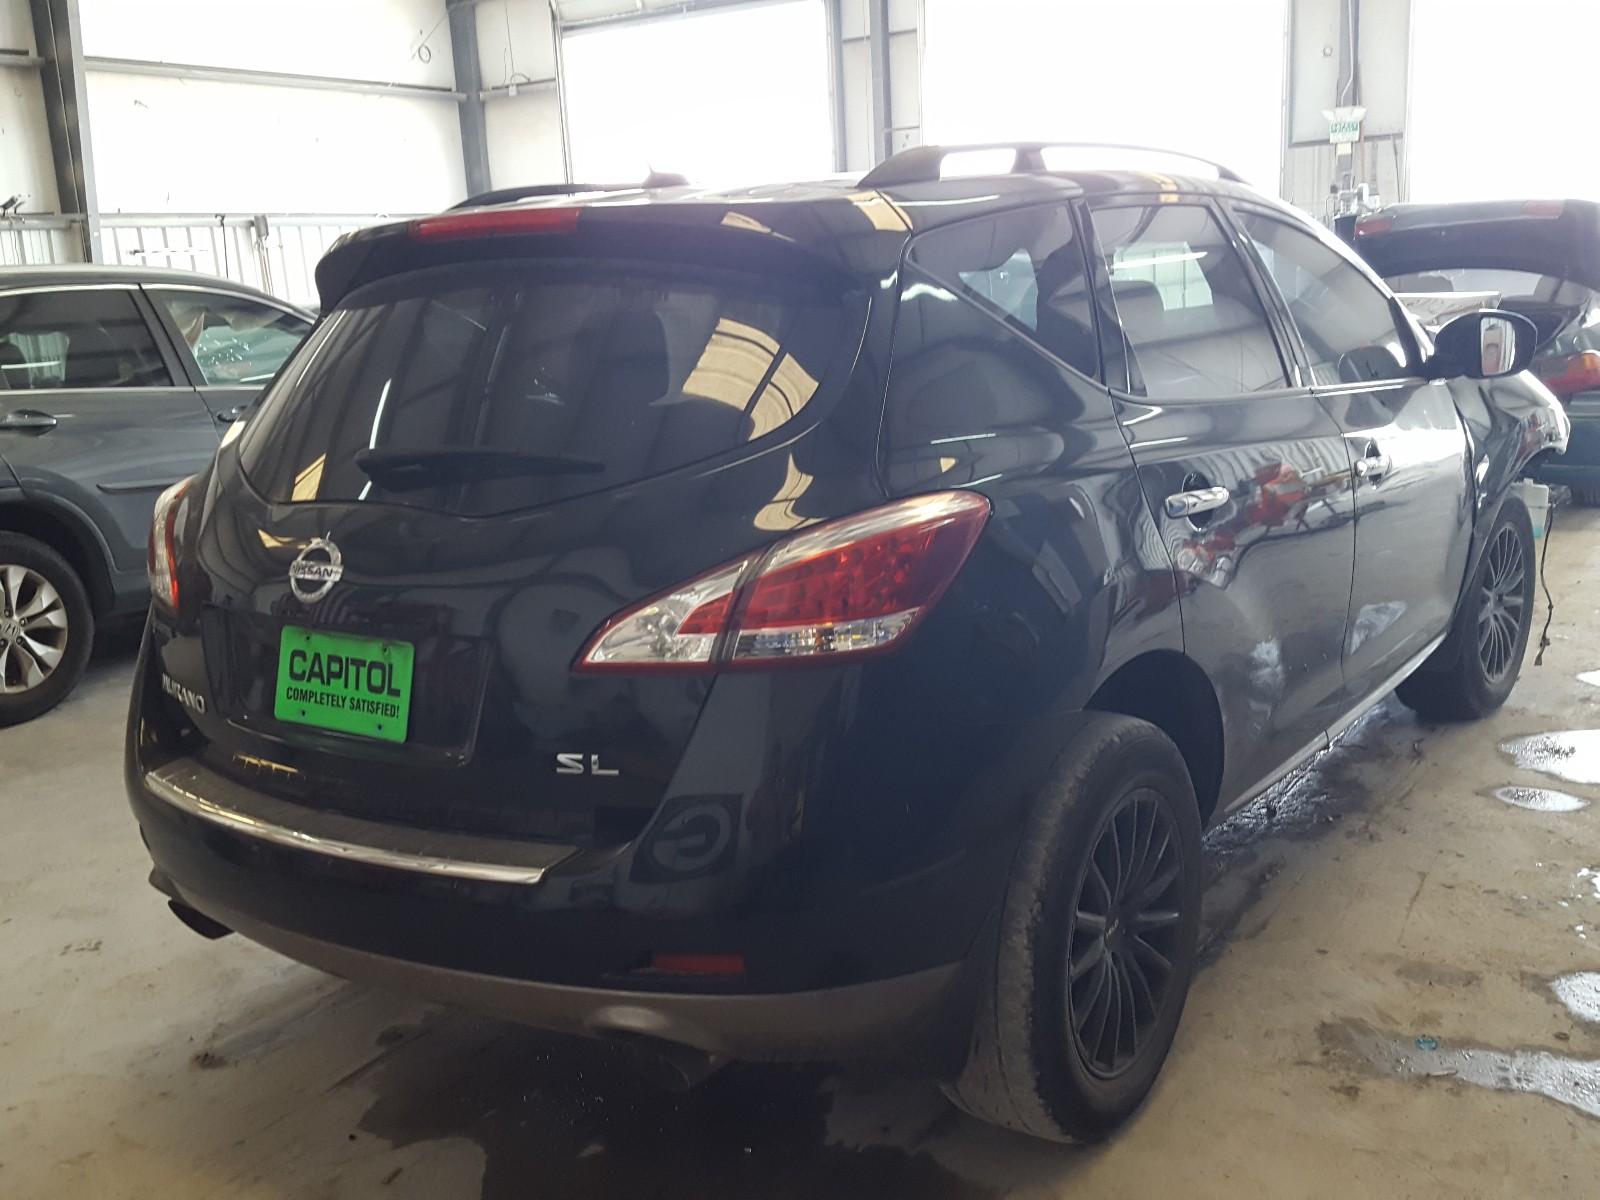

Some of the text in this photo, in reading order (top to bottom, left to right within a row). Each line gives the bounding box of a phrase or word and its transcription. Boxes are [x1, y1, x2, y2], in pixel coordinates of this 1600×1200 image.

[289, 649, 401, 698] CAPITOL
[286, 686, 400, 719] COMPLETELY SATISFIED!
[556, 753, 619, 775] SL
